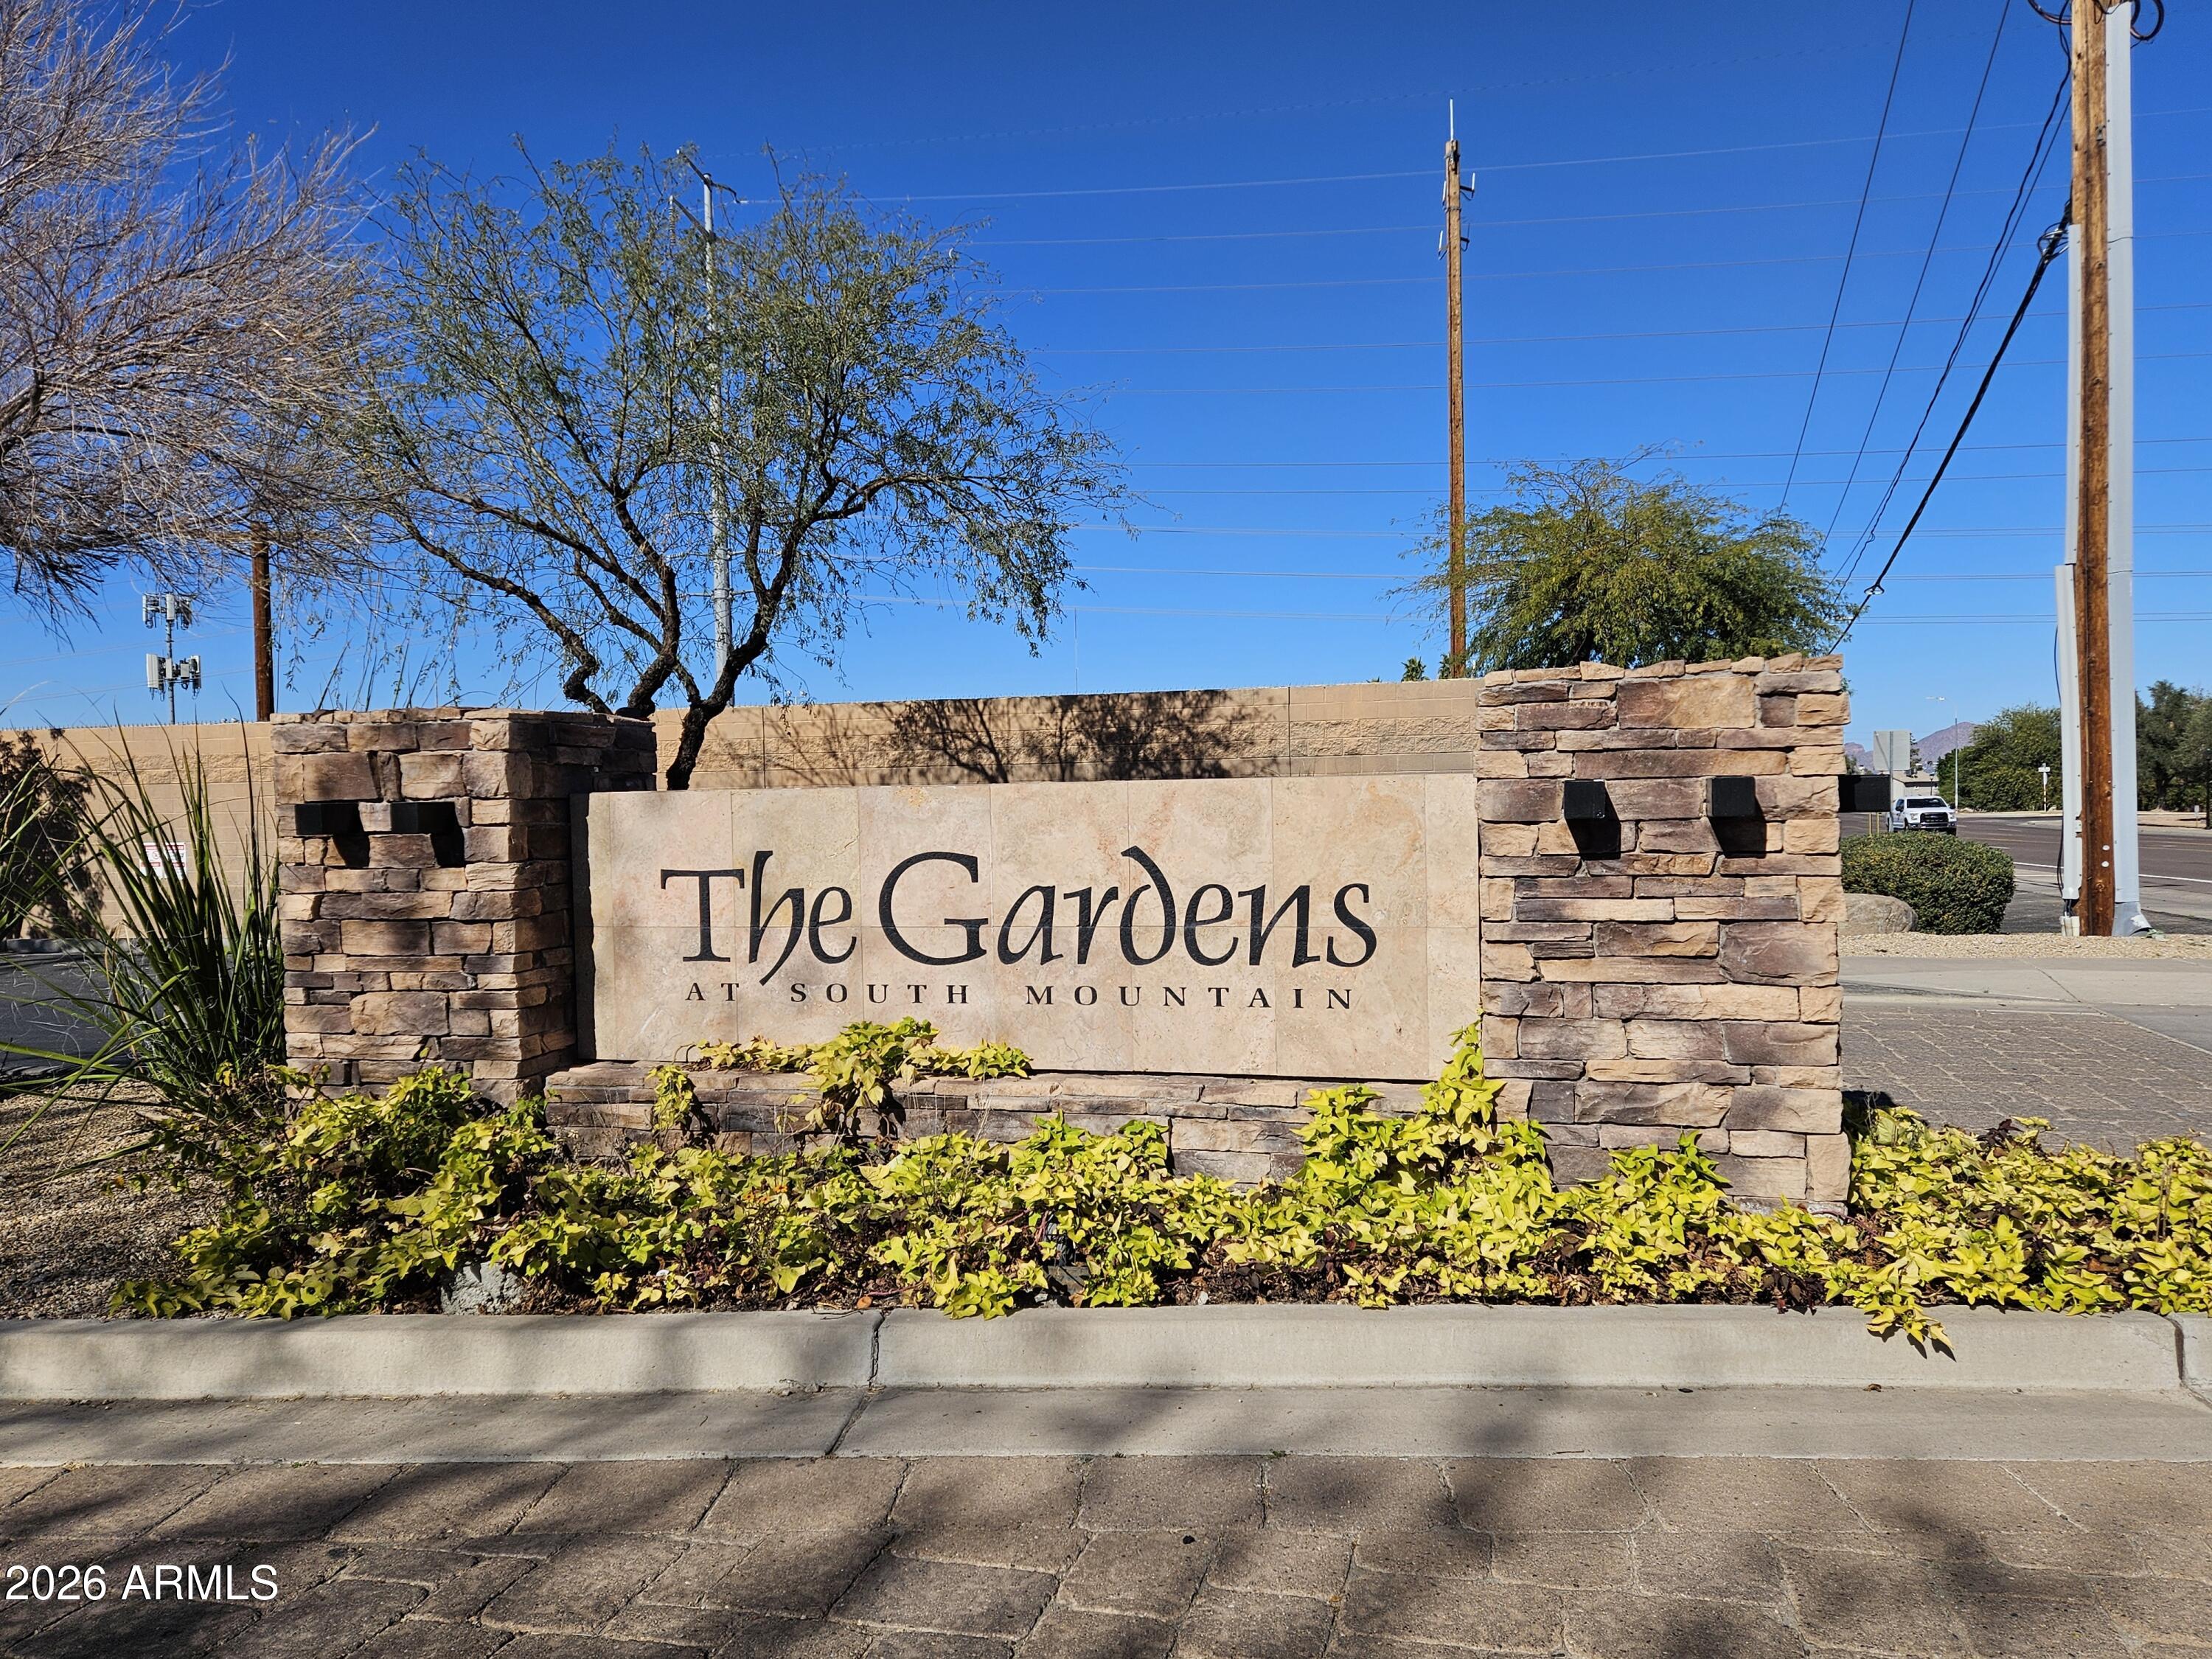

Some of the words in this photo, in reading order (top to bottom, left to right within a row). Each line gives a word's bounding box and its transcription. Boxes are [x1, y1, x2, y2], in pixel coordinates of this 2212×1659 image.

[660, 850, 858, 987] The
[878, 845, 1378, 969] Gardens
[685, 982, 740, 1002] AT
[790, 983, 970, 1005] SOUTH
[1025, 985, 1353, 1010] MOUNTAIN
